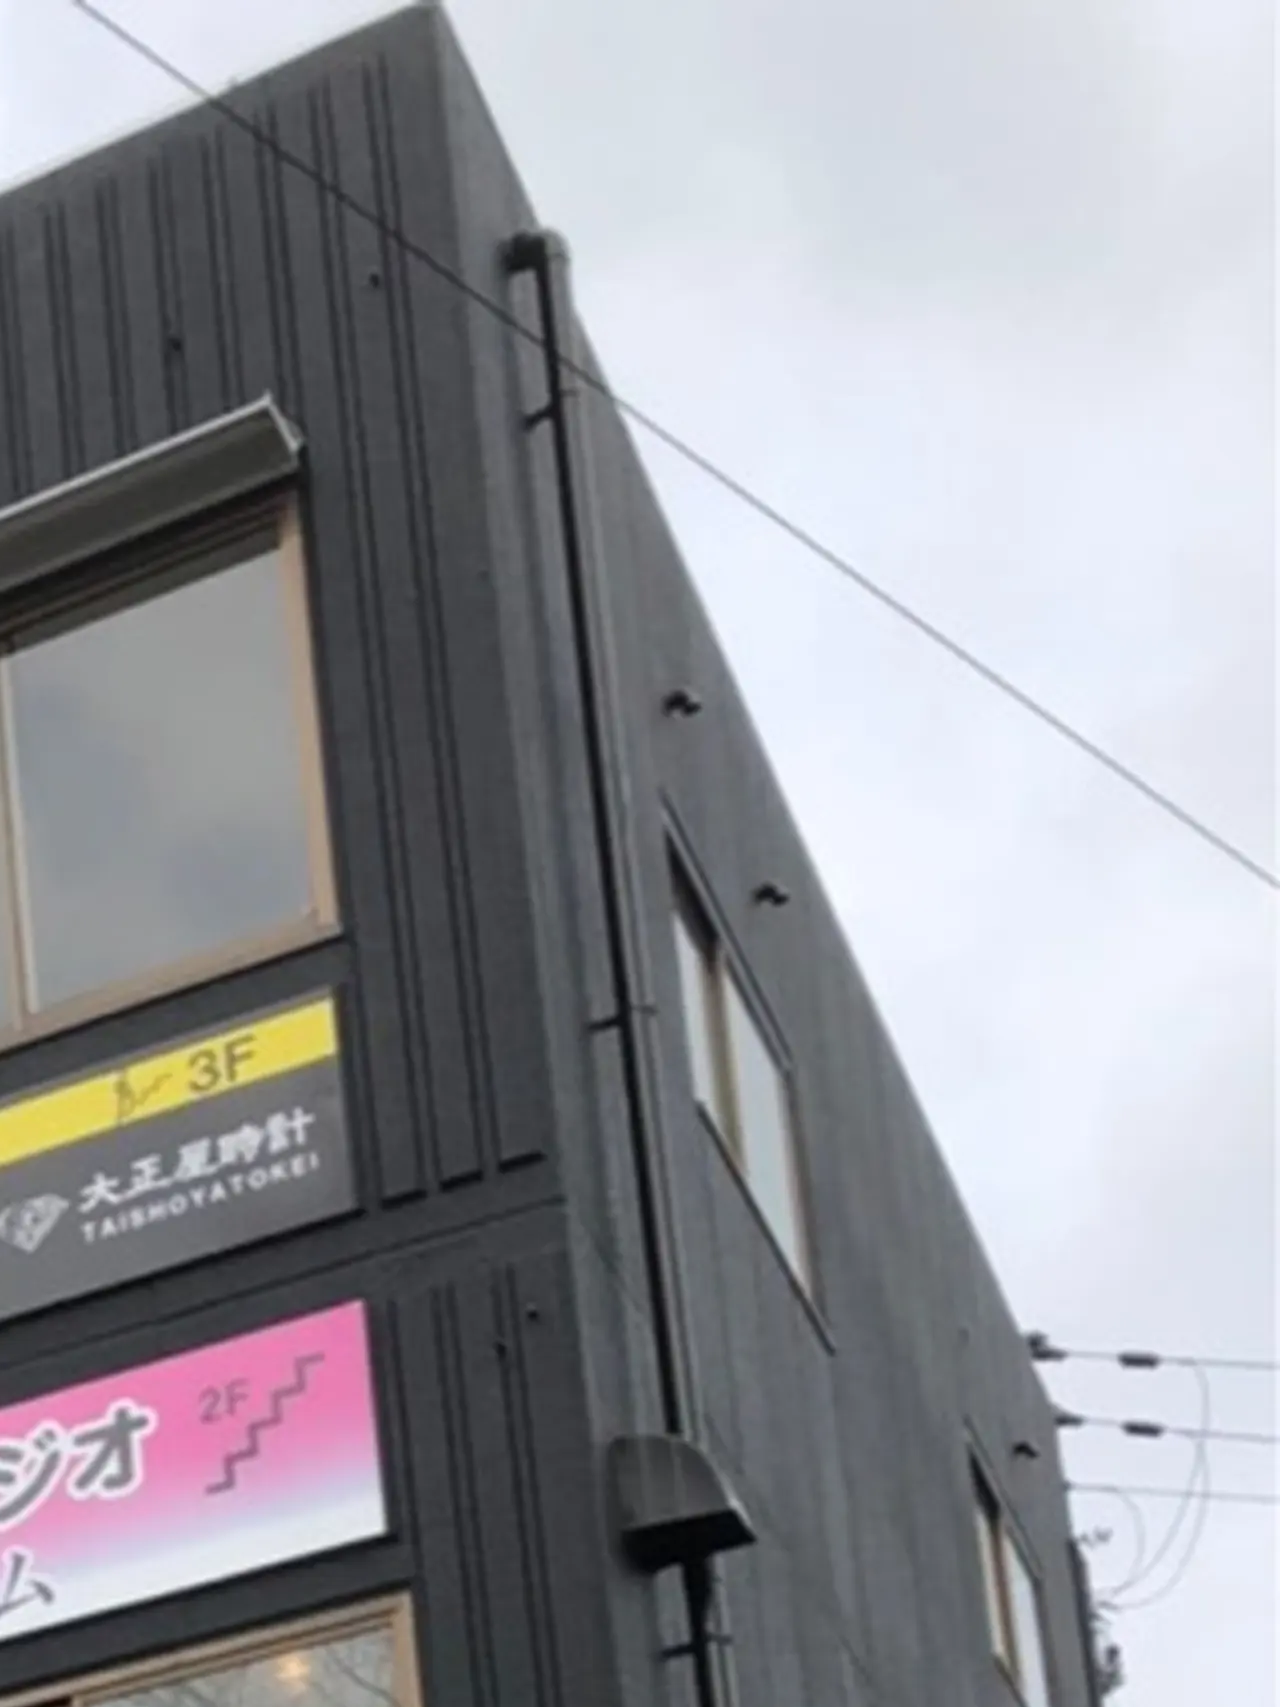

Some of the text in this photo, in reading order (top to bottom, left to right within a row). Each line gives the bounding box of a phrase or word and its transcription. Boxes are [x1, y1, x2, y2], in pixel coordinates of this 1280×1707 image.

[188, 1034, 257, 1092] 3F
[78, 1106, 316, 1214] 大正屋時計
[81, 1152, 320, 1244] TAISHOYATOKEI
[199, 1381, 250, 1424] 2F
